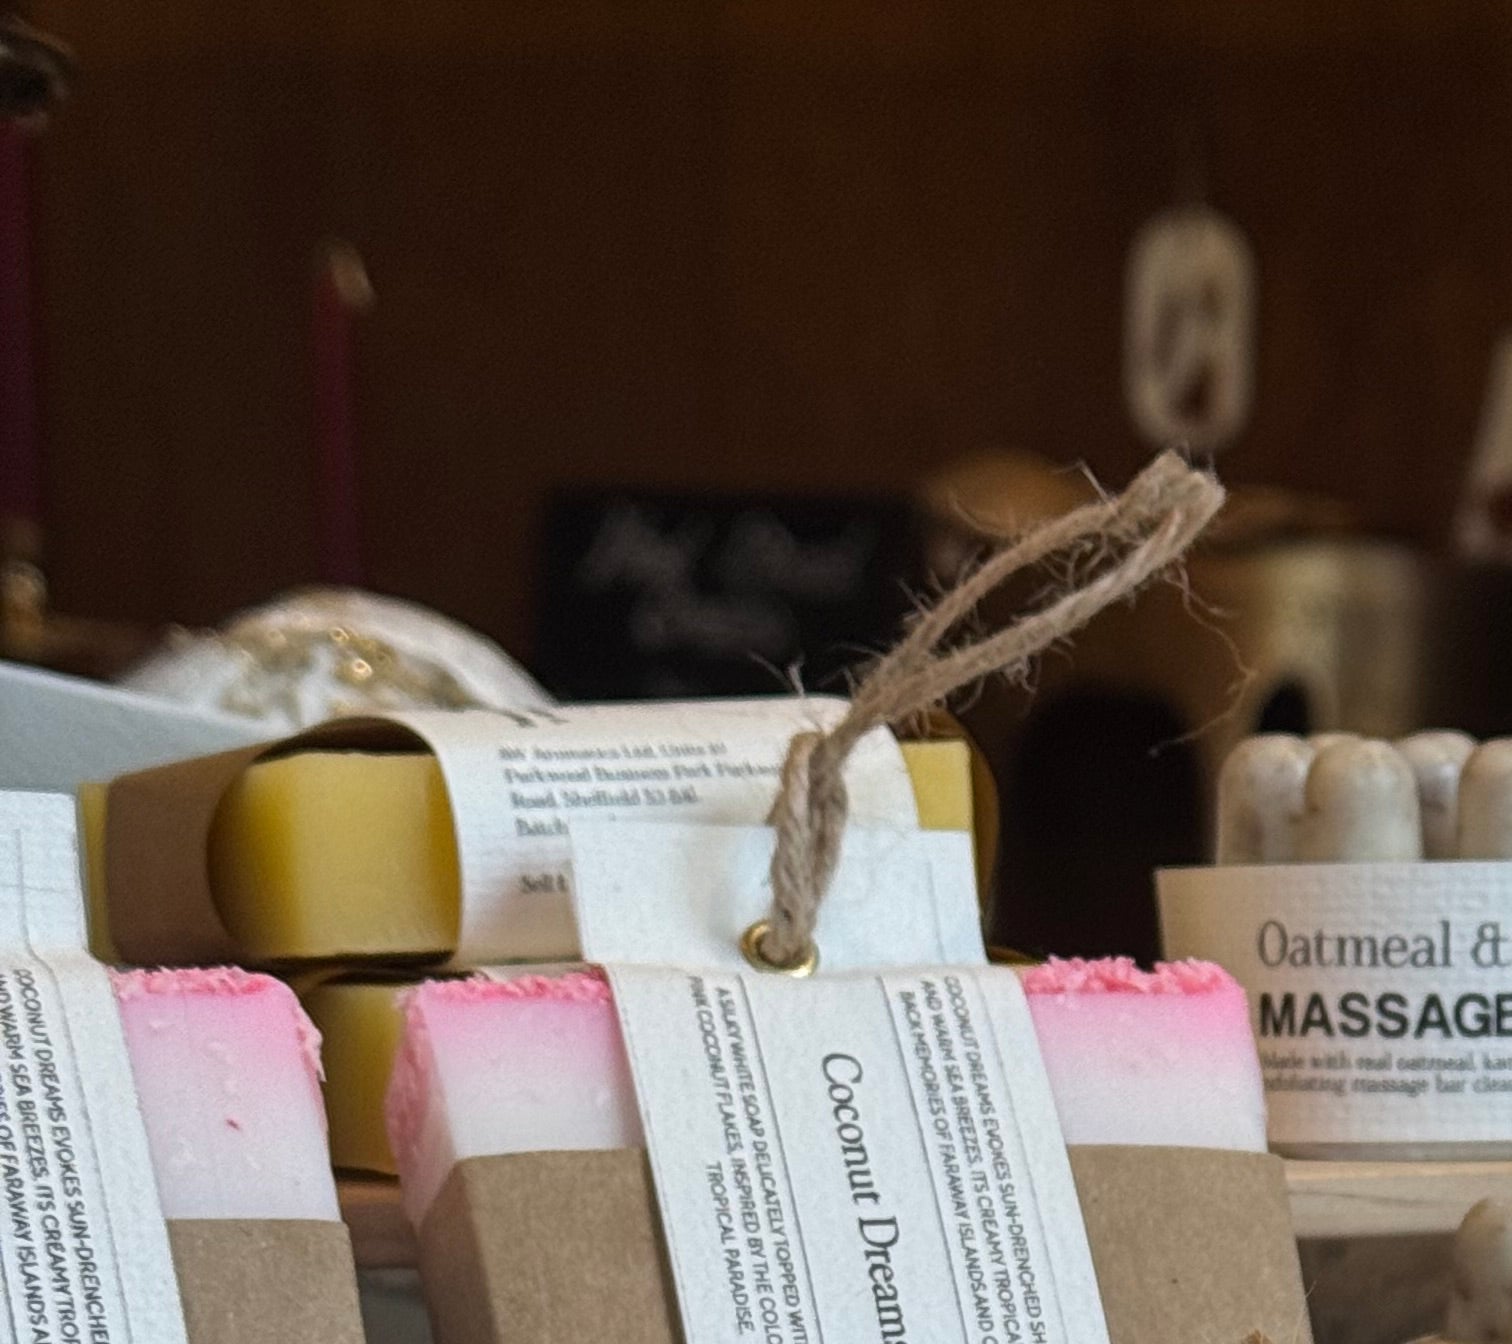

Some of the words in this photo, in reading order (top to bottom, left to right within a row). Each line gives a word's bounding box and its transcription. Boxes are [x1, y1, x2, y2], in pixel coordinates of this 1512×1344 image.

[1256, 919, 1453, 970] Oatmeal
[1471, 922, 1512, 969] &
[688, 976, 709, 1006] PINK
[899, 991, 923, 1028] BACK
[921, 981, 942, 1009] AND
[696, 1010, 729, 1089] COCONUT
[730, 1043, 755, 1090] WHITE
[930, 1014, 956, 1060] WARM
[9, 1063, 32, 1095] SEA
[34, 1049, 67, 1122] DREAMS
[910, 1032, 946, 1114] MEMORIES
[944, 1065, 965, 1092] SEA
[742, 1095, 765, 1136] SOAP
[821, 1053, 880, 1204] Coconut
[932, 1118, 951, 1137] OF
[943, 976, 977, 1048] COCONUT
[963, 1052, 995, 1114] DREAMS
[981, 1118, 1011, 1179] EVOKES
[997, 1183, 1042, 1317] SUN-DRENCHED
[50, 1126, 82, 1196] EVOKES
[751, 1141, 786, 1235] DELICATELY
[938, 1144, 969, 1218] FARAWAY
[970, 1171, 989, 1192] ITS
[0, 1154, 32, 1240] FARAWAY
[33, 1185, 55, 1210] ITS
[704, 1161, 737, 1244] TROPICAL
[730, 1158, 760, 1232] INSPIRED
[39, 1215, 72, 1297] CREAMY
[746, 1238, 765, 1258] BY
[957, 1223, 985, 1290] ISLANDS
[976, 1196, 1005, 1264] CREAMY
[15, 1245, 47, 1324] ISLANDS
[751, 1262, 772, 1293] THE
[772, 1239, 801, 1306] TOPPED
[972, 1295, 994, 1331] AND
